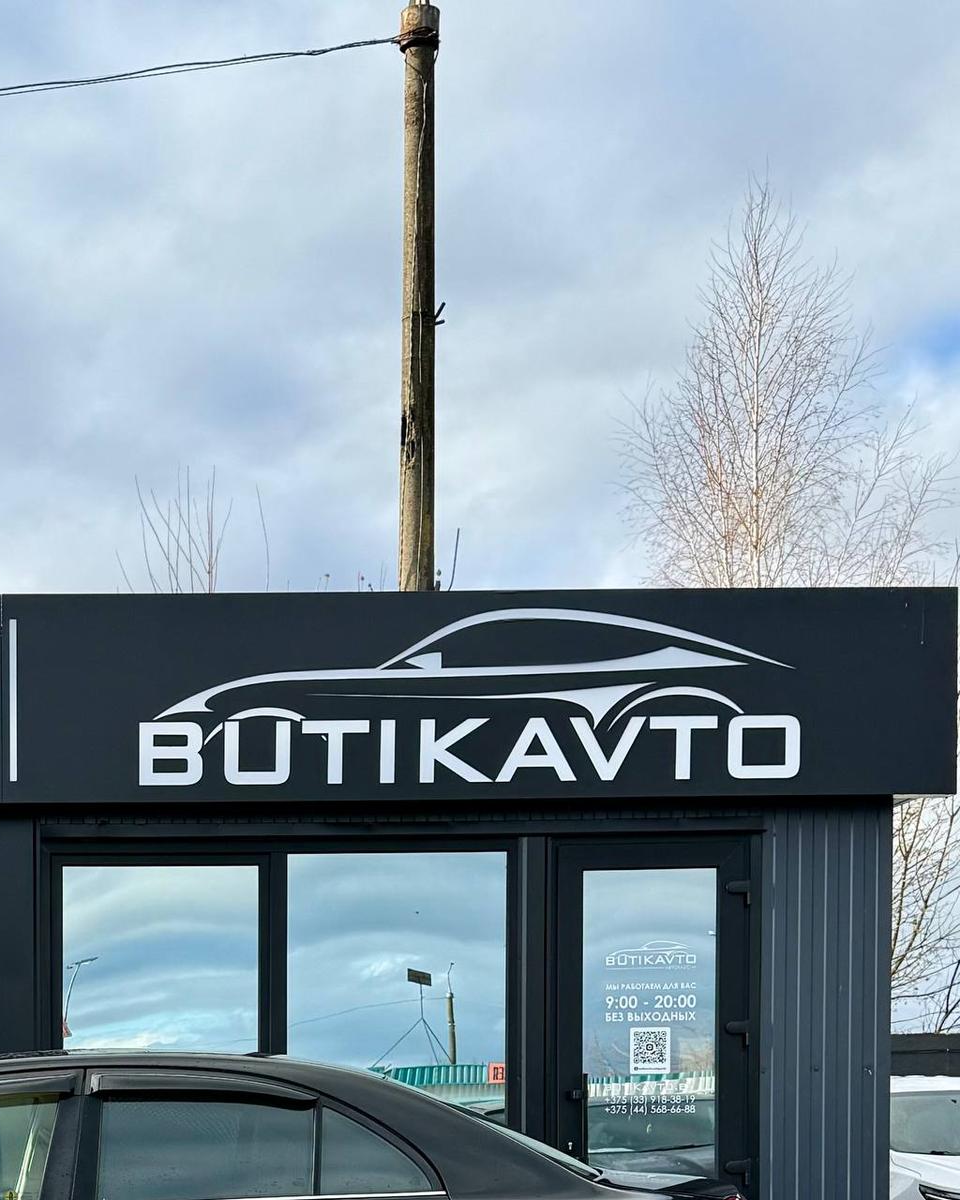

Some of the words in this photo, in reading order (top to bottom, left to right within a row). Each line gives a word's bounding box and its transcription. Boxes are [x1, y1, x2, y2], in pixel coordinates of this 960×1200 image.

[138, 714, 802, 786] BUTIKAVTO
[605, 954, 697, 966] BUTIKAVTO
[662, 982, 678, 990] ДЛЯ
[605, 995, 638, 1009] 9:00
[654, 995, 697, 1008] 20:00
[605, 1012, 624, 1022] БЕЗ
[627, 1011, 696, 1022] ВЫХОДНЫХ
[605, 1096, 627, 1104] +375
[630, 1095, 647, 1105] (33)
[650, 1095, 696, 1104] 918-38-19
[605, 1106, 627, 1114] +375
[630, 1105, 647, 1116] (44)
[650, 1105, 696, 1114] 568-66-88
